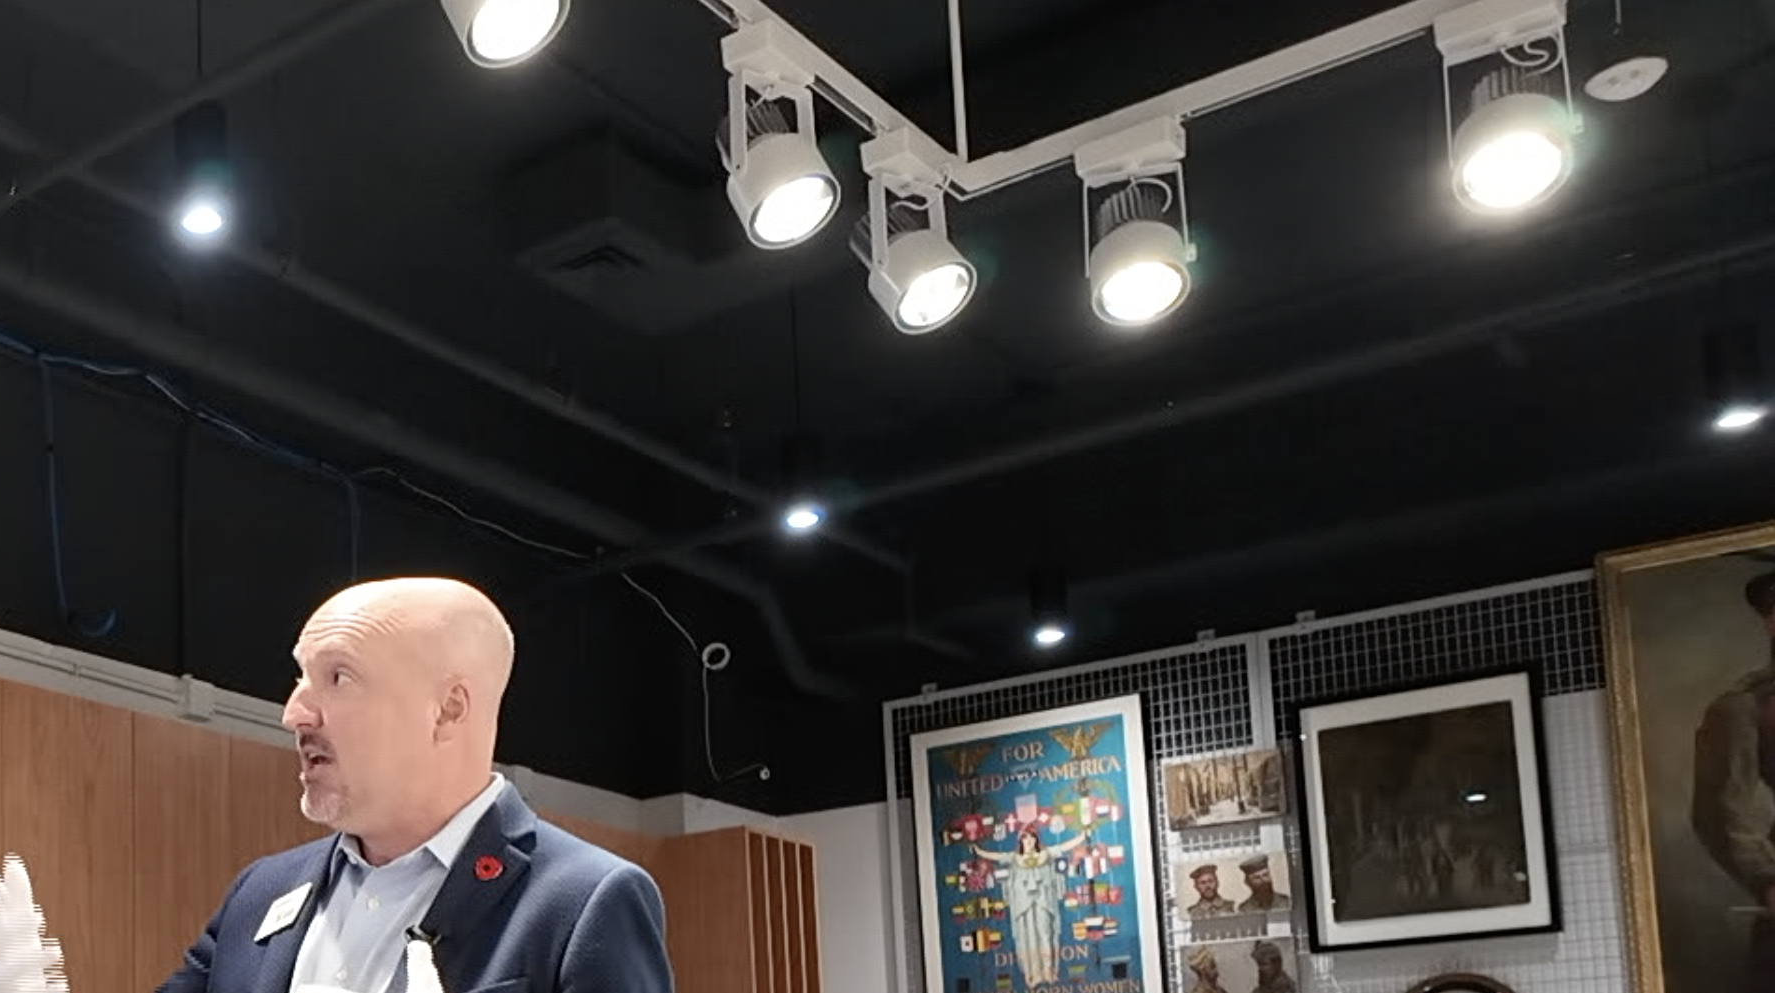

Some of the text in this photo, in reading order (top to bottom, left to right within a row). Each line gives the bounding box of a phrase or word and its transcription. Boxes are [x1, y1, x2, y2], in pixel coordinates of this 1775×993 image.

[1002, 741, 1045, 763] FOR
[936, 774, 1004, 799] UNITED
[1038, 755, 1122, 783] AMERICA
